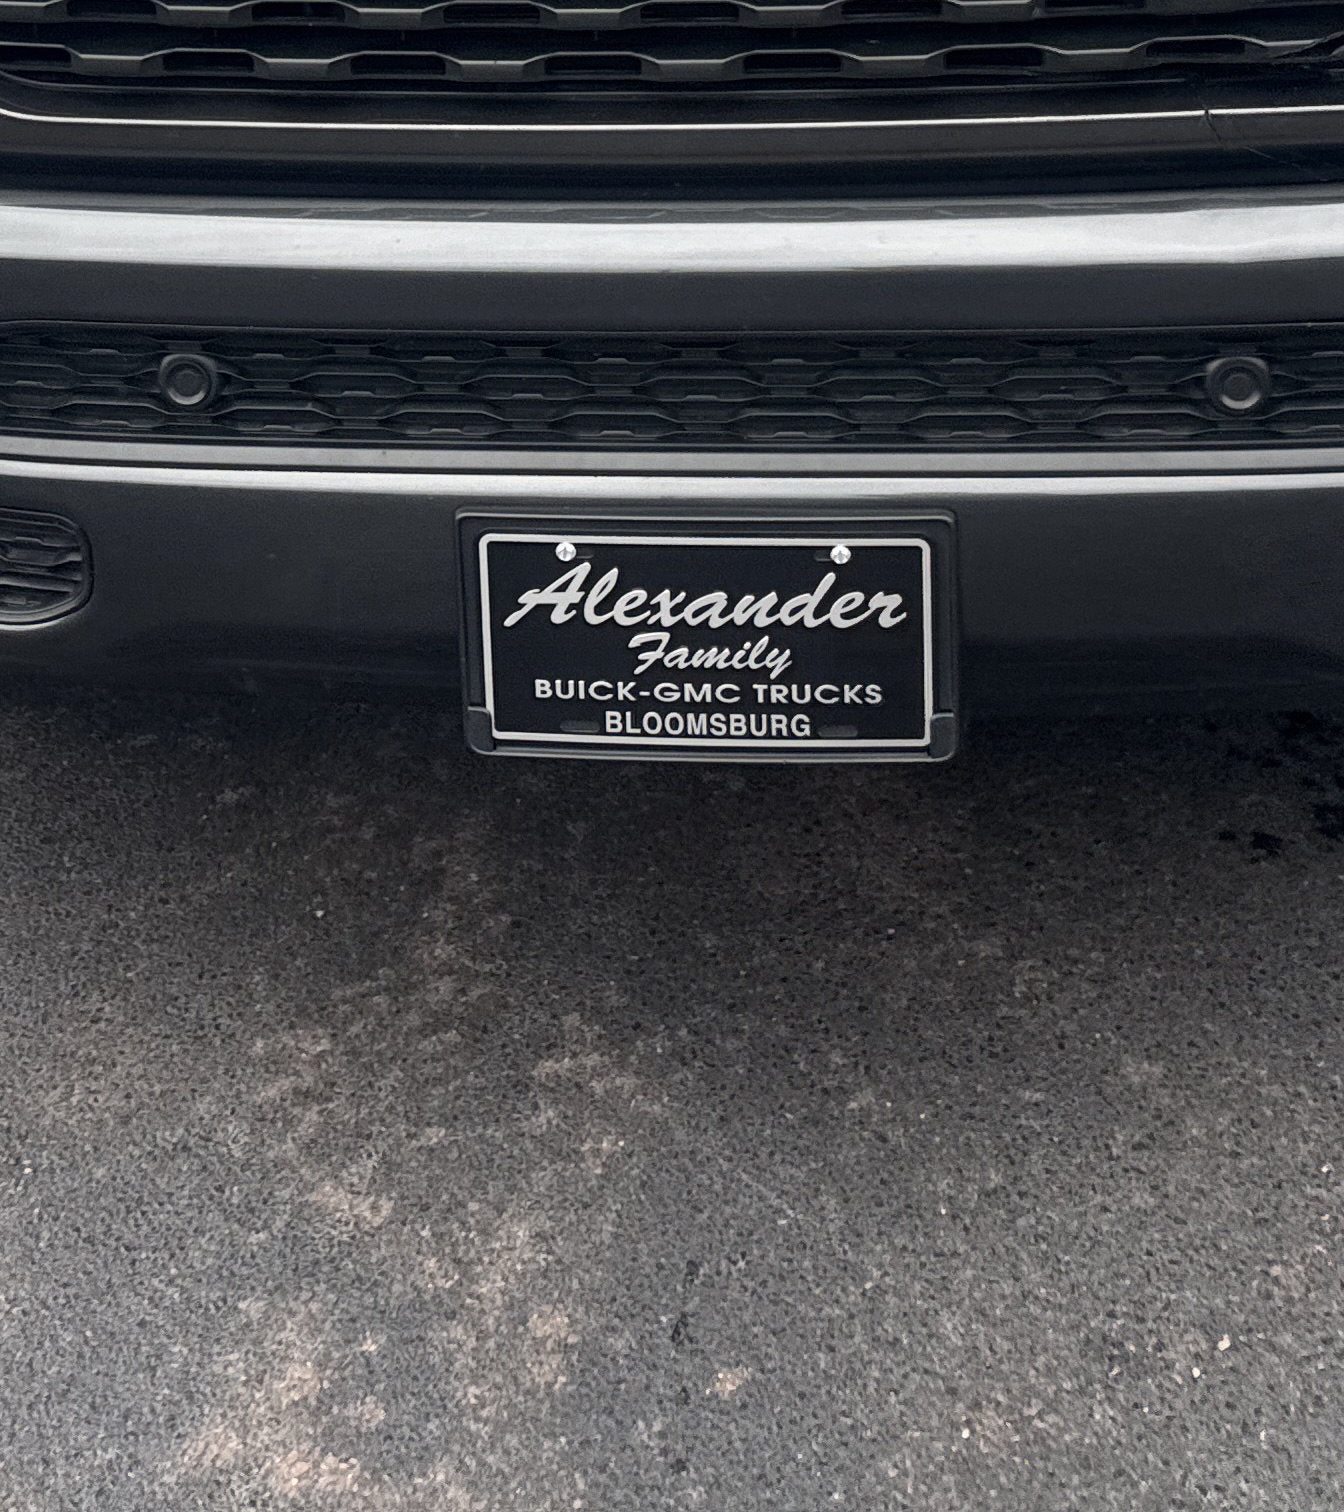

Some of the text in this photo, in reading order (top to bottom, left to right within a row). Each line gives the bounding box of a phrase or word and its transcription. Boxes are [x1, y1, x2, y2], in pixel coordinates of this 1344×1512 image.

[504, 562, 907, 628] Alexander
[627, 632, 792, 679] Family
[535, 679, 883, 704] BUICK-GMC TRUCKS
[605, 711, 811, 737] BLOOMSBURG
